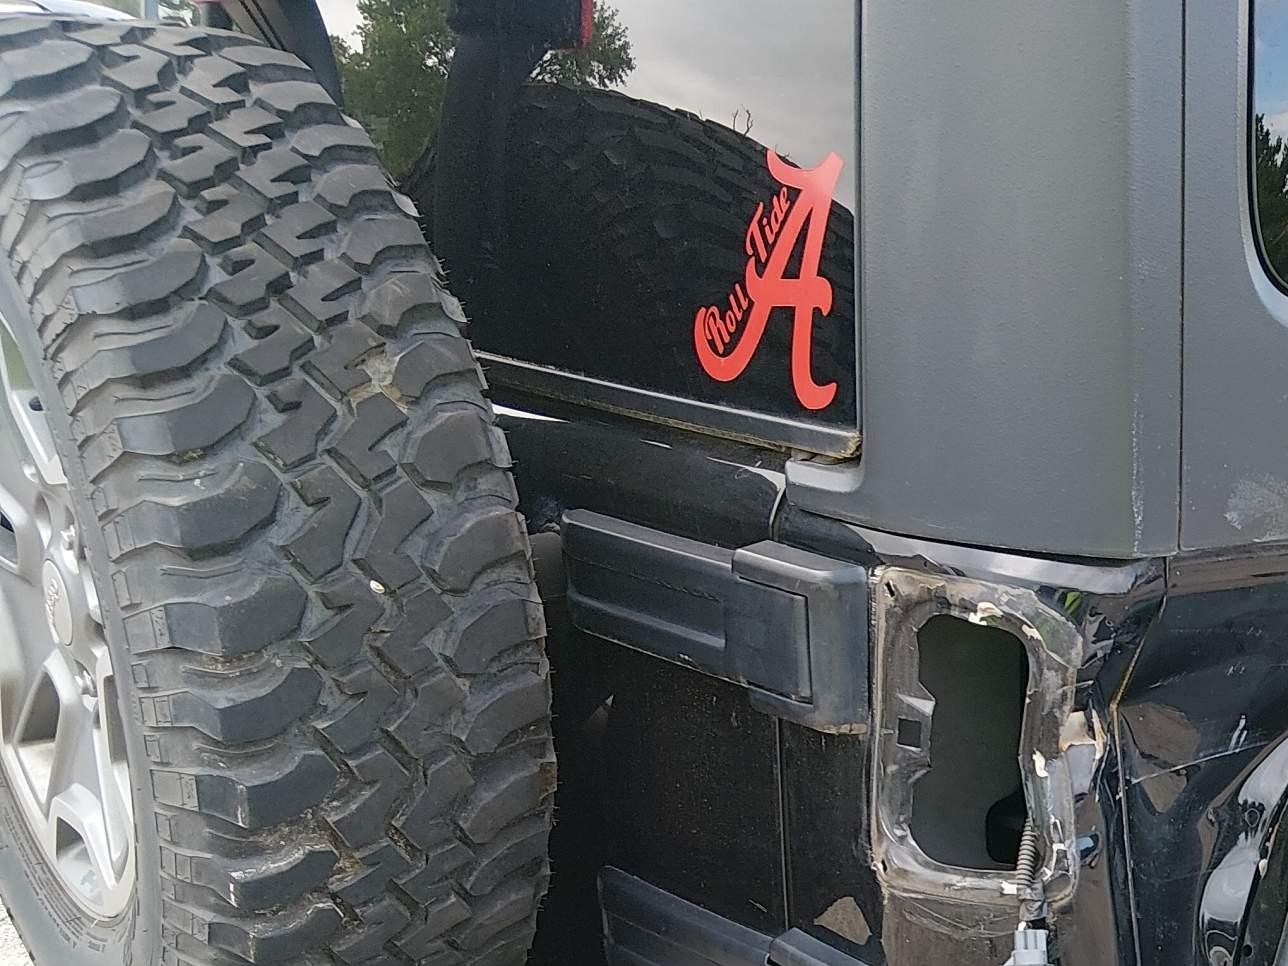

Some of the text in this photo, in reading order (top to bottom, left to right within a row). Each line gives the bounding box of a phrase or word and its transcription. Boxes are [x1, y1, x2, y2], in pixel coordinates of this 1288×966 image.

[693, 150, 844, 410] A
[706, 187, 790, 354] Roll Tide
